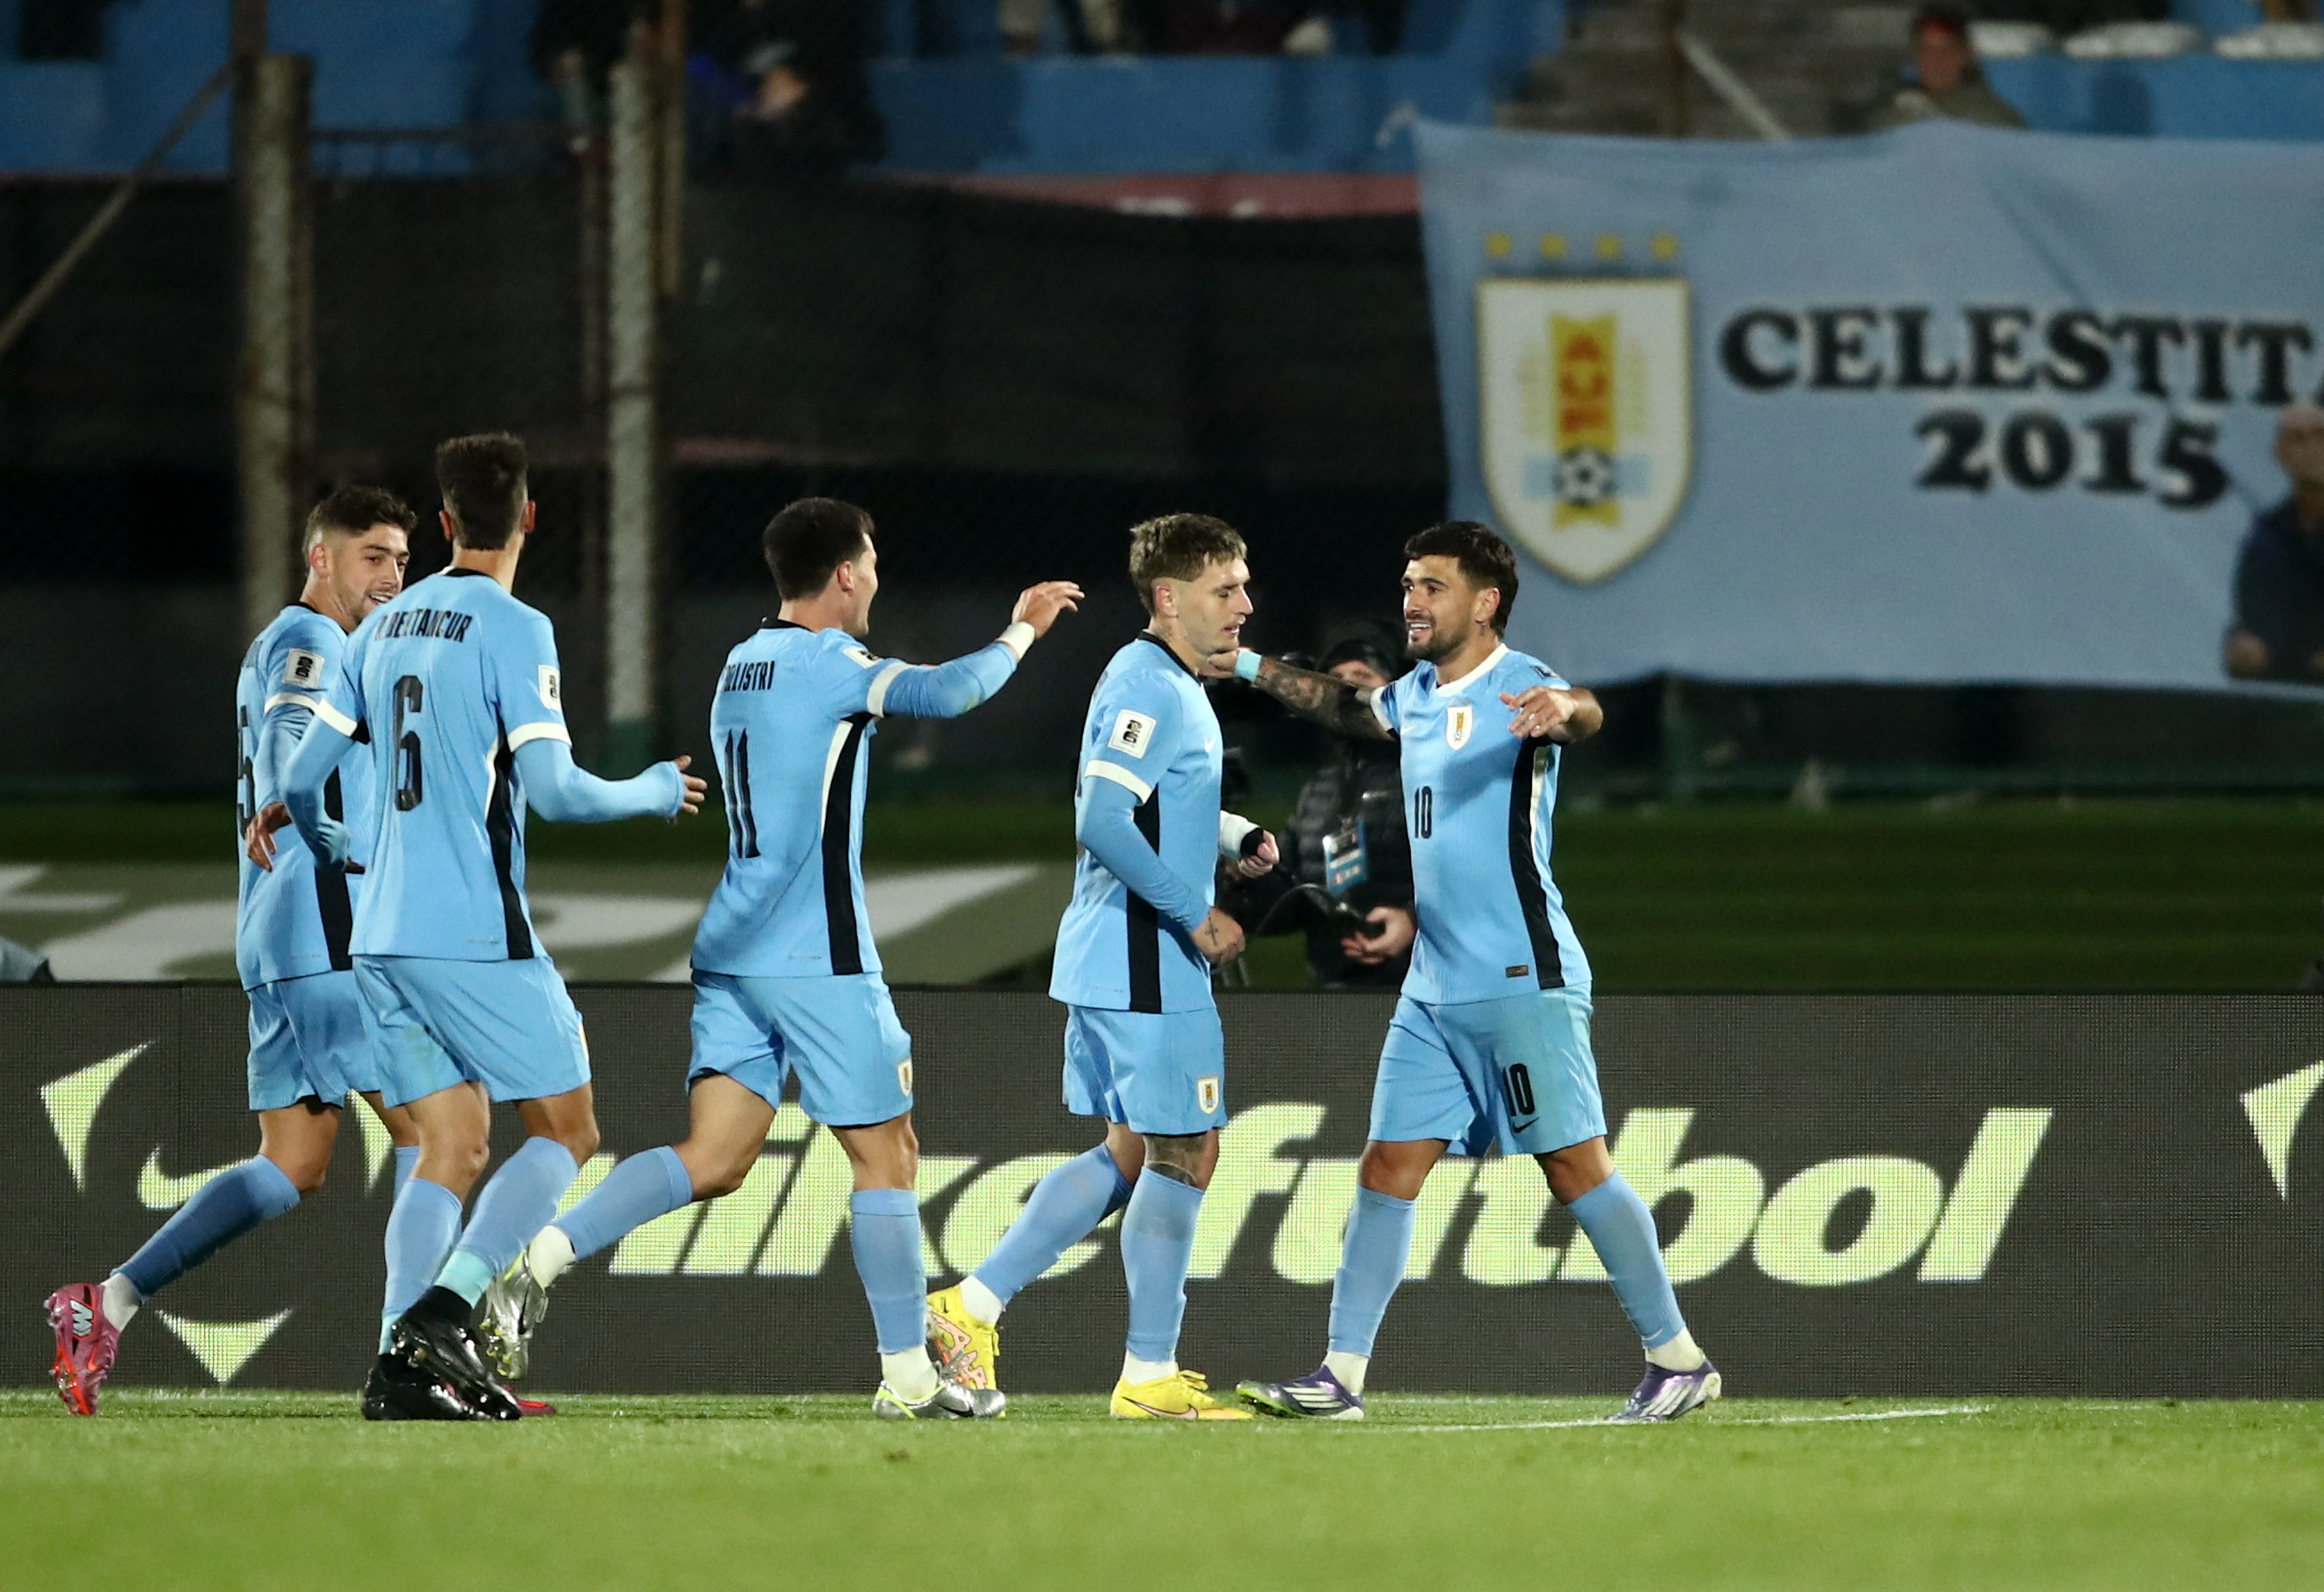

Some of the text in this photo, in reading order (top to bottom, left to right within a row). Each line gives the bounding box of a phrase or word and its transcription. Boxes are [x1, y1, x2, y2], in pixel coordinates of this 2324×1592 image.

[1719, 306, 2324, 407] CELESTIT
[1913, 409, 2230, 509] 2015
[393, 675, 423, 812] 6
[724, 728, 761, 860] 11
[1414, 786, 1432, 839] 10
[1502, 1063, 1535, 1116] 10
